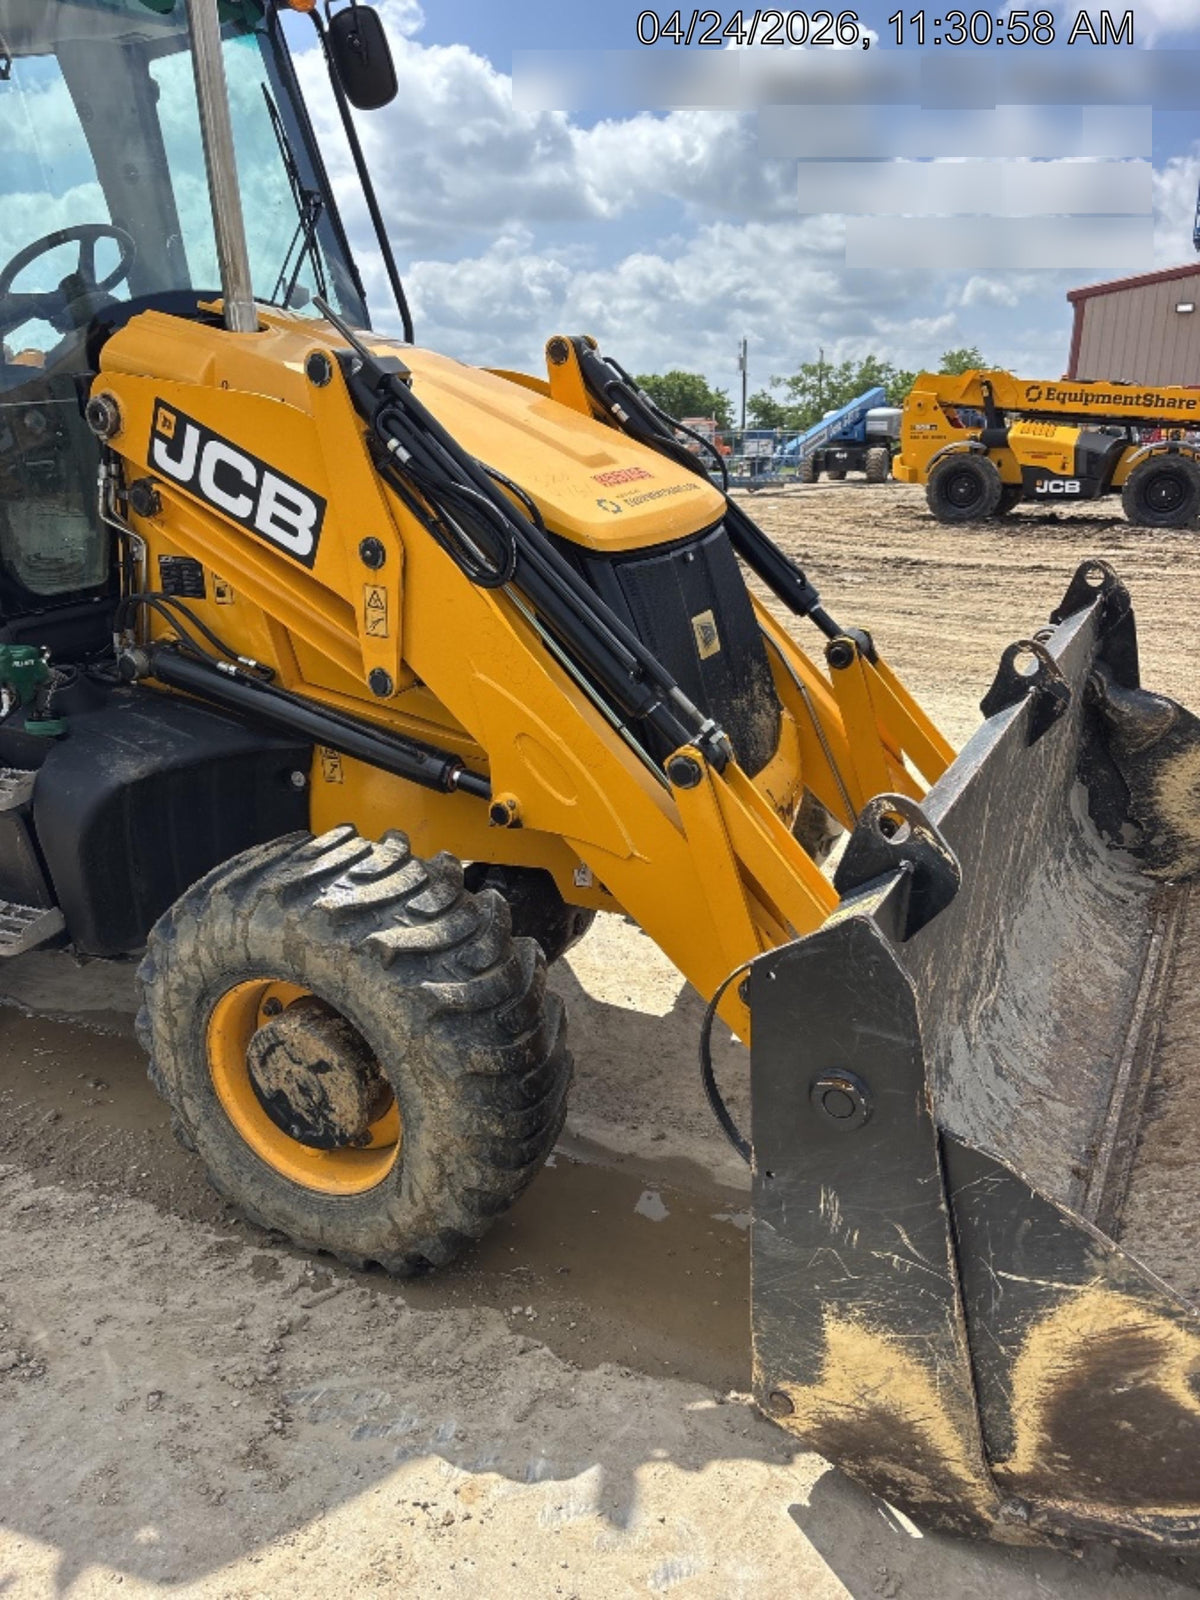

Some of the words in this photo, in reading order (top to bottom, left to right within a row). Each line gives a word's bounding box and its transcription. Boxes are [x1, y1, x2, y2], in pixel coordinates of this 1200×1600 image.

[1045, 387, 1197, 410] EquipmentShare
[153, 424, 317, 556] JCB
[1035, 479, 1081, 494] JCB
